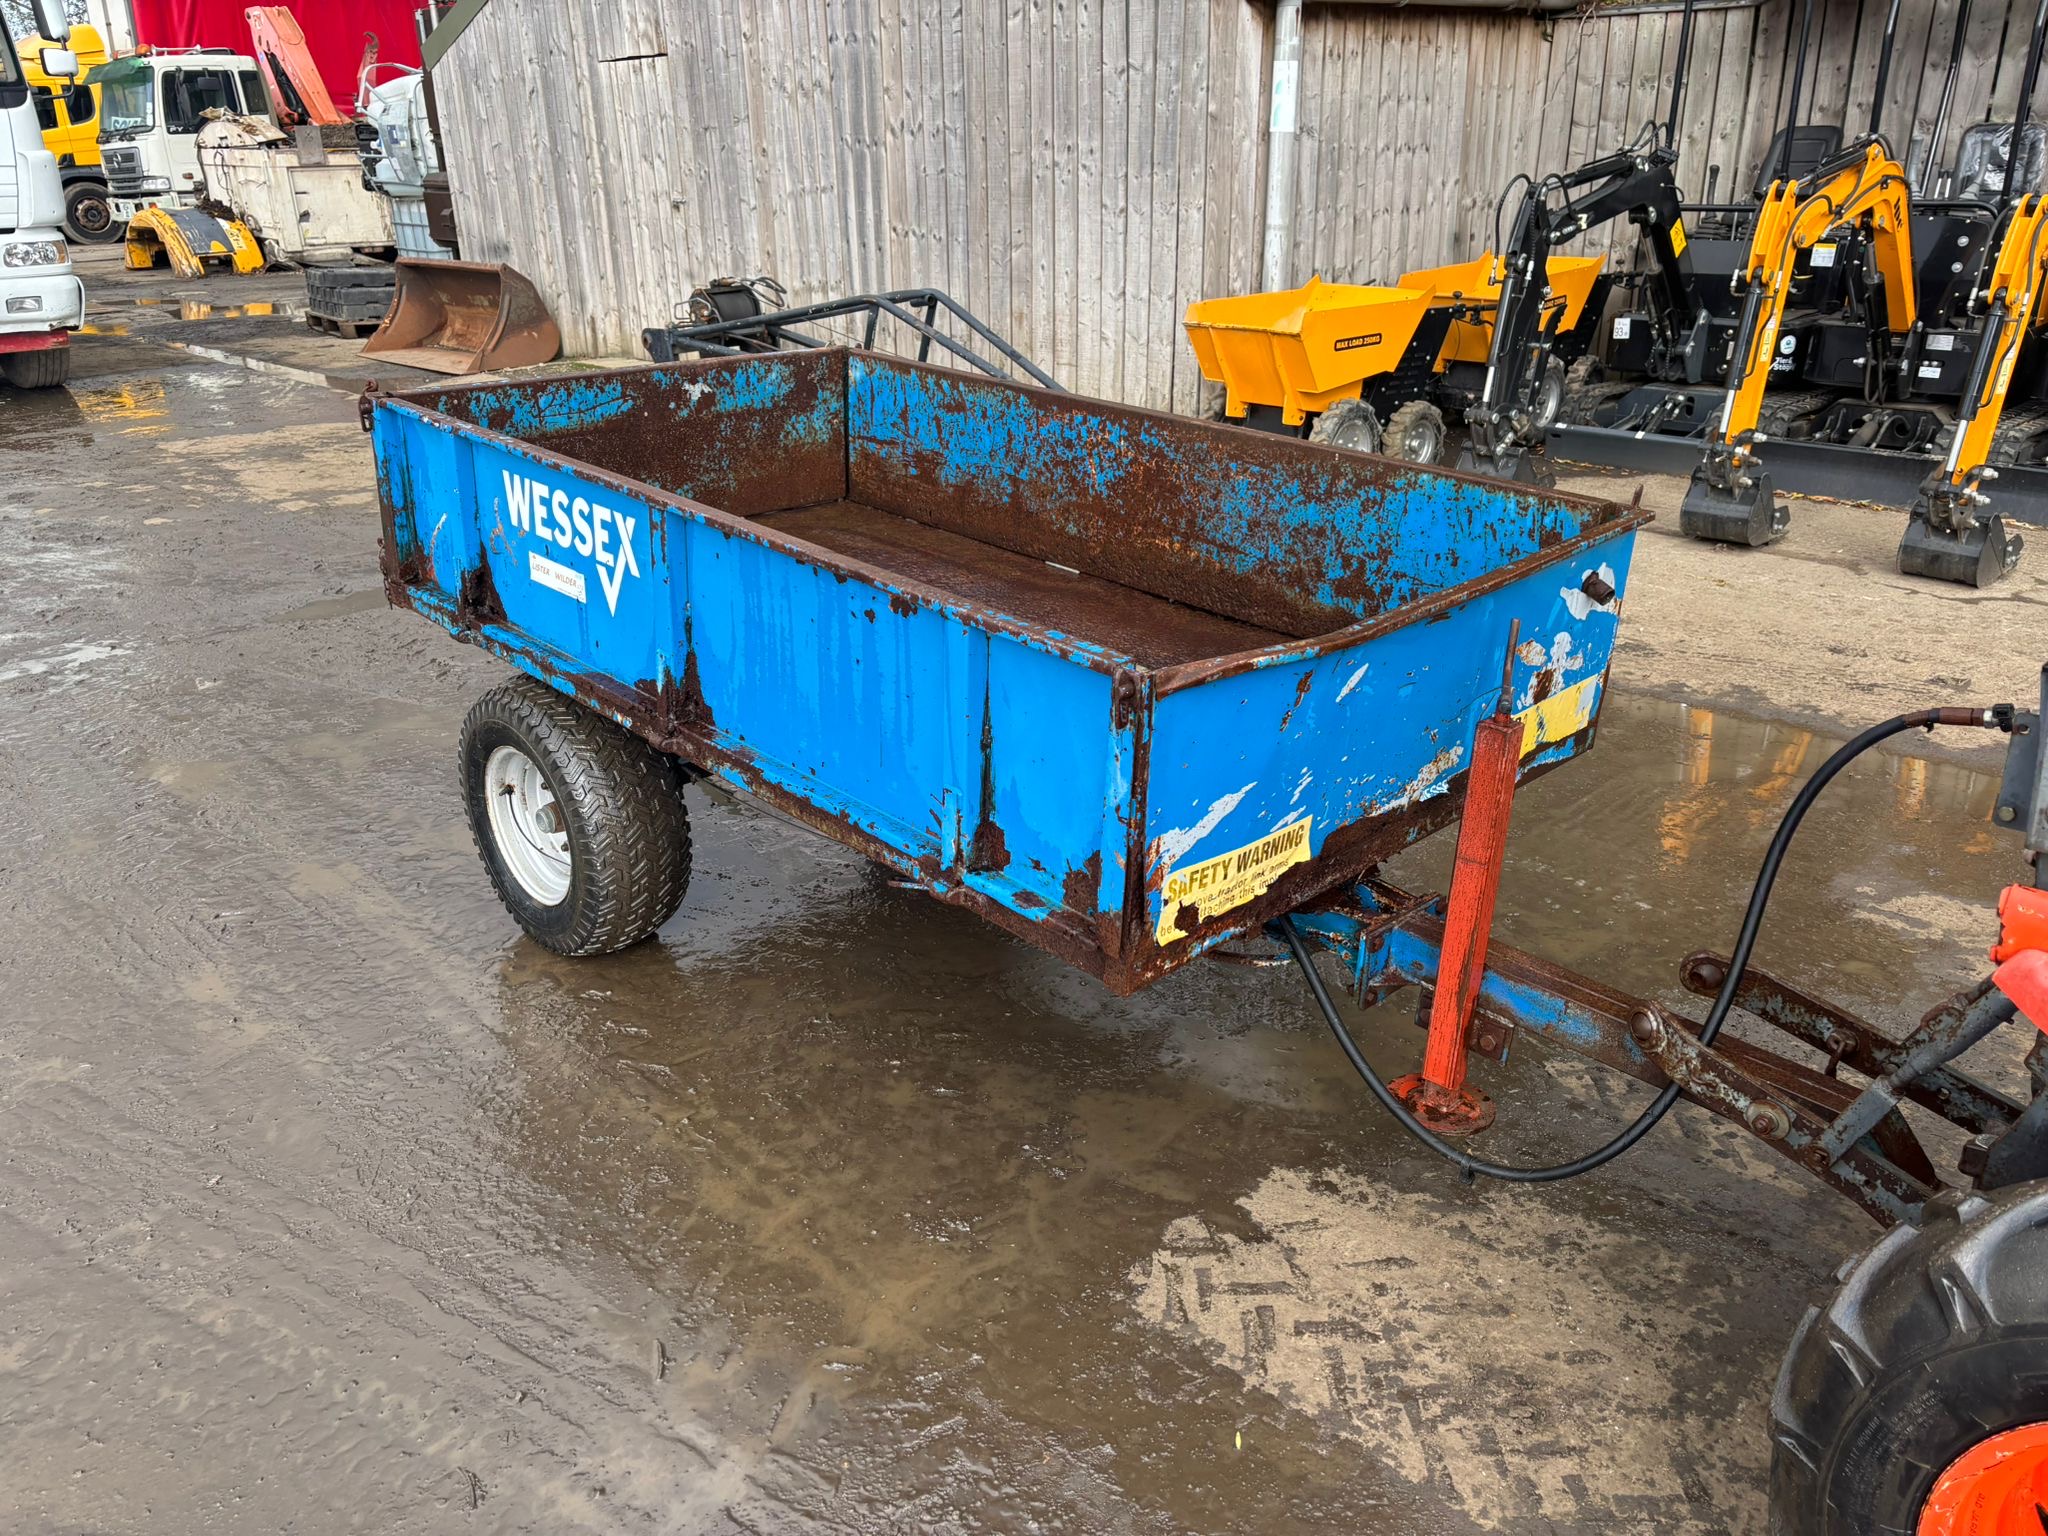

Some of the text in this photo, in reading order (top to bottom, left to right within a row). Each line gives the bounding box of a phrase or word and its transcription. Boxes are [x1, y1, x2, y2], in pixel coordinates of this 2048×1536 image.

[502, 469, 641, 617] WESSEX
[531, 561, 550, 576] LISTER
[554, 571, 578, 588] WILDER
[1168, 824, 1305, 903] SAFETY WARNING
[1238, 884, 1255, 900] this
